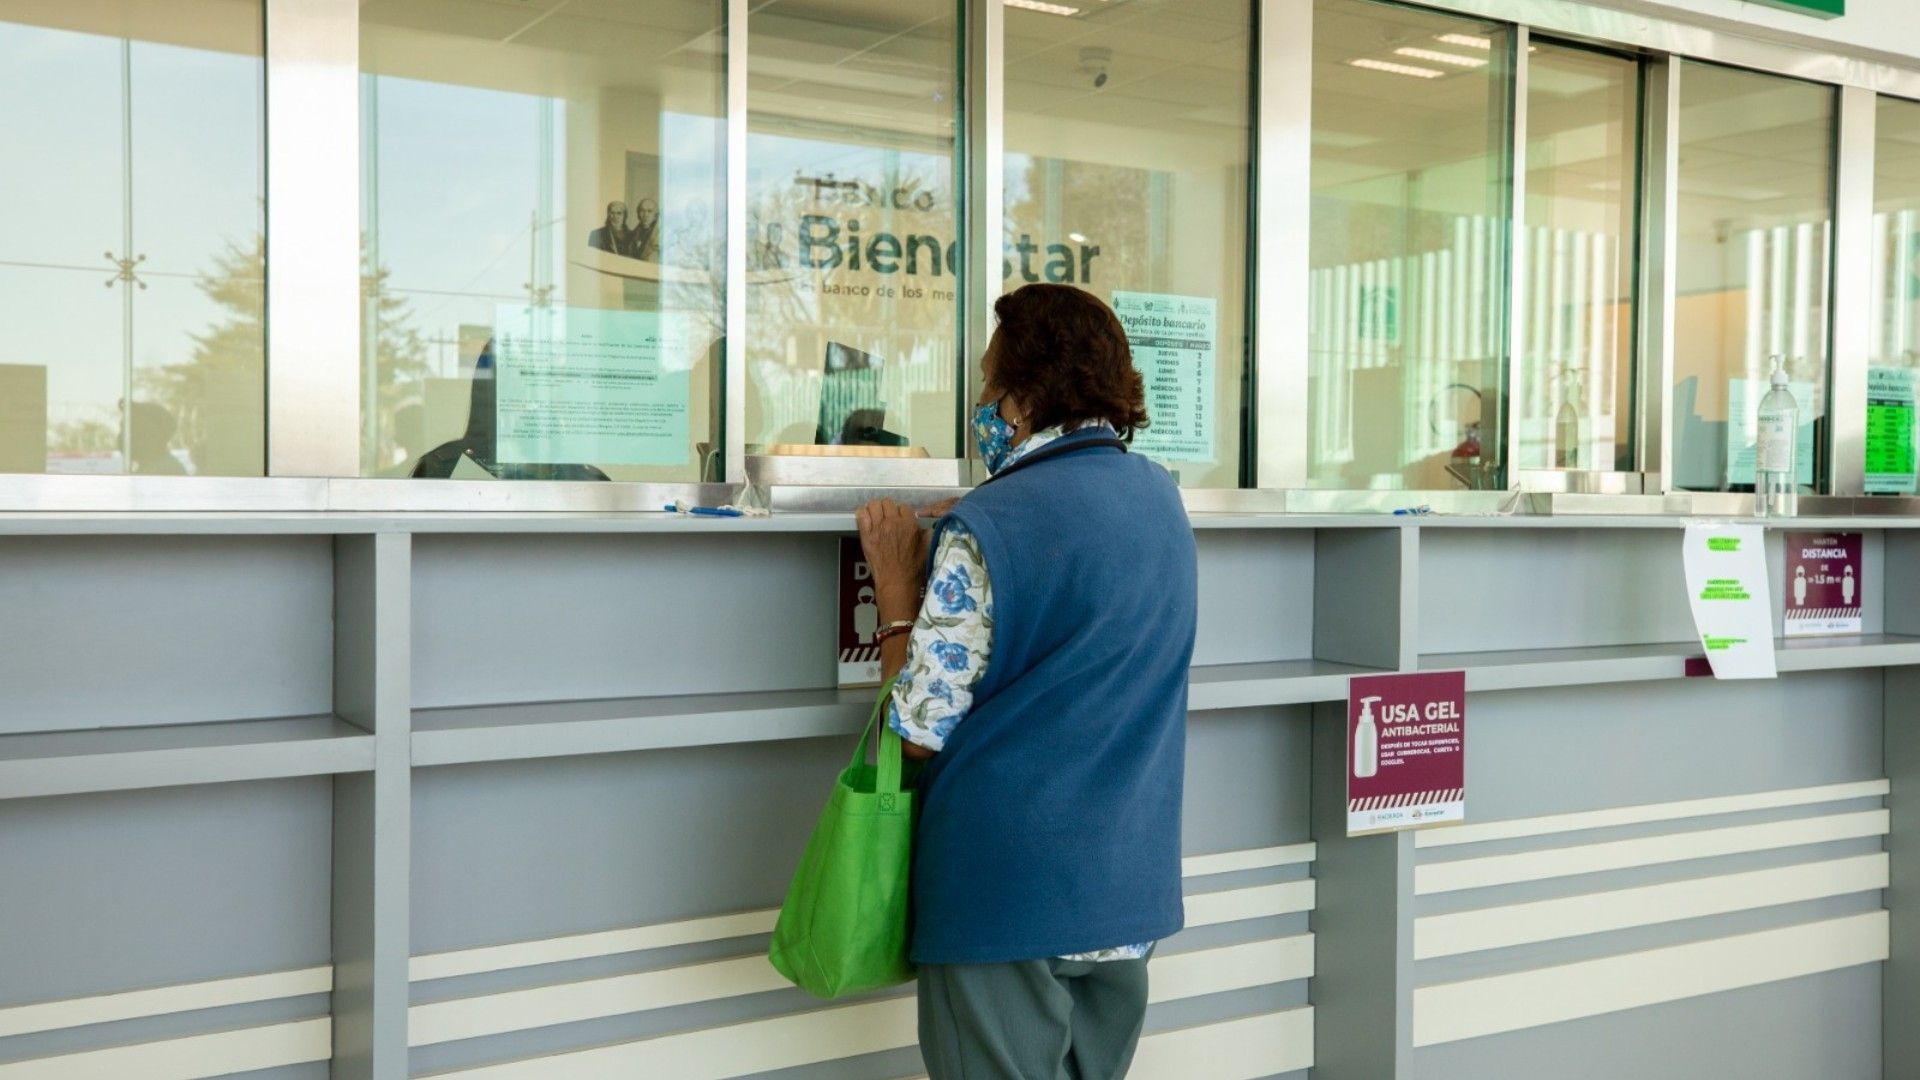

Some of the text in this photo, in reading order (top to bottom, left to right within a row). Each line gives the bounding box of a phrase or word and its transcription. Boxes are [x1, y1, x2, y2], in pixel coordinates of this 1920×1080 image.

[799, 214, 1100, 284] Bientar
[822, 281, 869, 297] banco
[876, 284, 895, 298] de
[903, 285, 924, 299] los
[1120, 314, 1206, 330] Depósito bancario
[1802, 548, 1847, 559] DISTANCIA
[1820, 564, 1829, 572] DE
[1381, 700, 1460, 724] USA GEL
[1381, 722, 1460, 738] ANTIBACTERIAL
[1411, 740, 1428, 748] TOCAR
